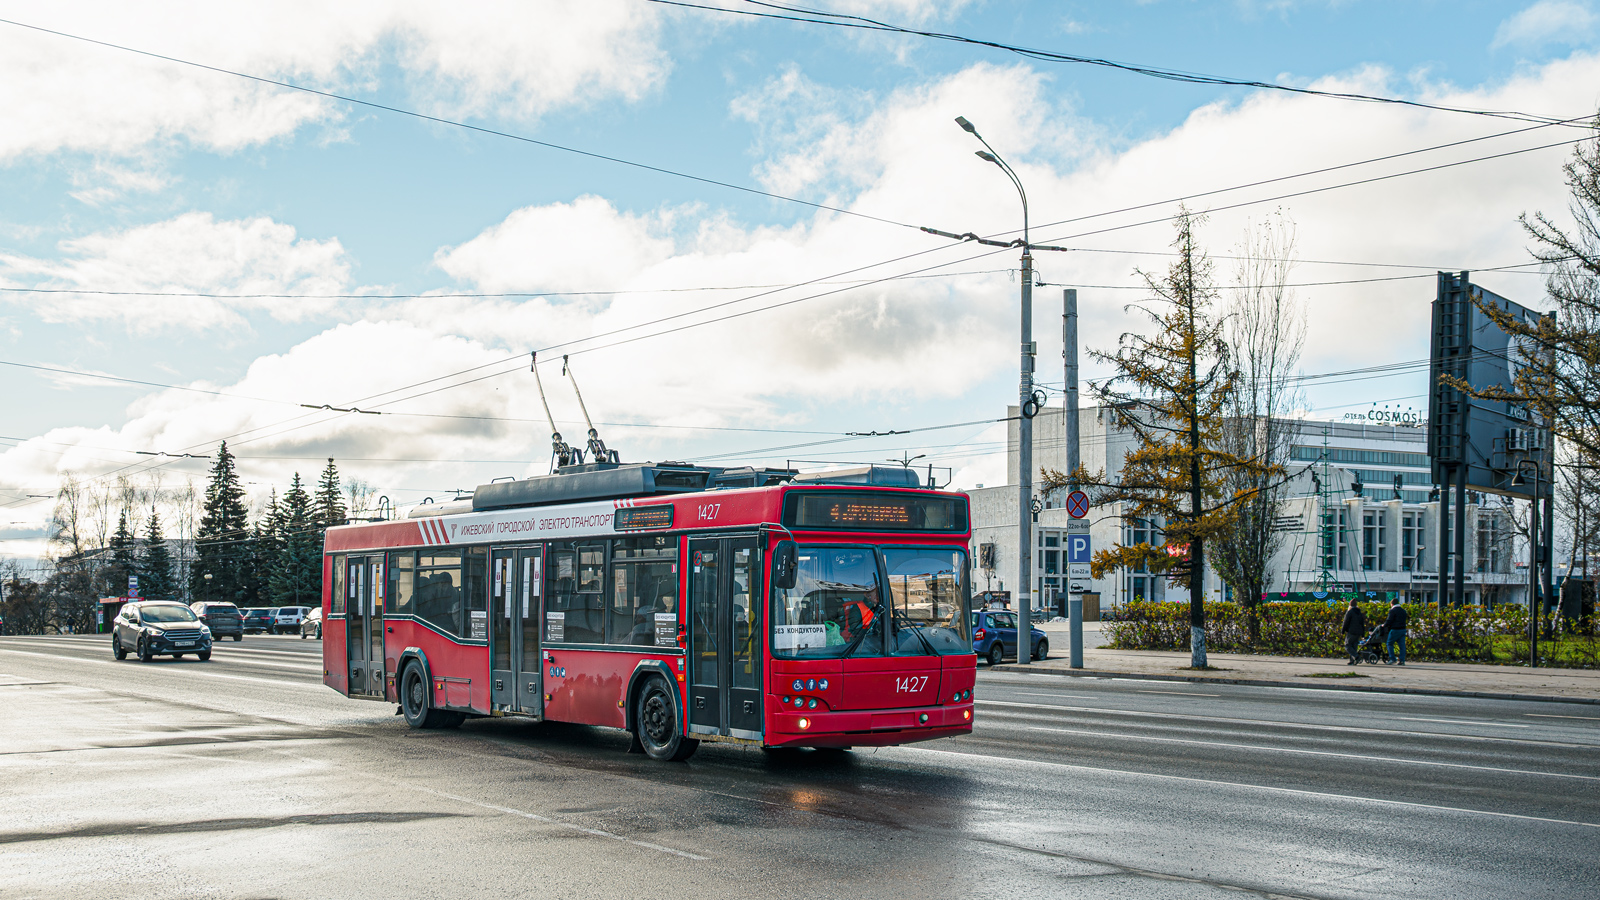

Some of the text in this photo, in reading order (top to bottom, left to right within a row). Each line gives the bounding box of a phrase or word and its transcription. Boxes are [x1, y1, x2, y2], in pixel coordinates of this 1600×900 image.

[1368, 409, 1417, 423] COSMOS
[697, 503, 721, 520] 1427
[460, 521, 494, 536] ИЖЕВСКИЙ
[497, 517, 536, 534] ГОРОДСКОЙ
[1073, 538, 1086, 560] P
[787, 627, 824, 635] КОНДУКТОРА
[895, 676, 929, 693] 1427
